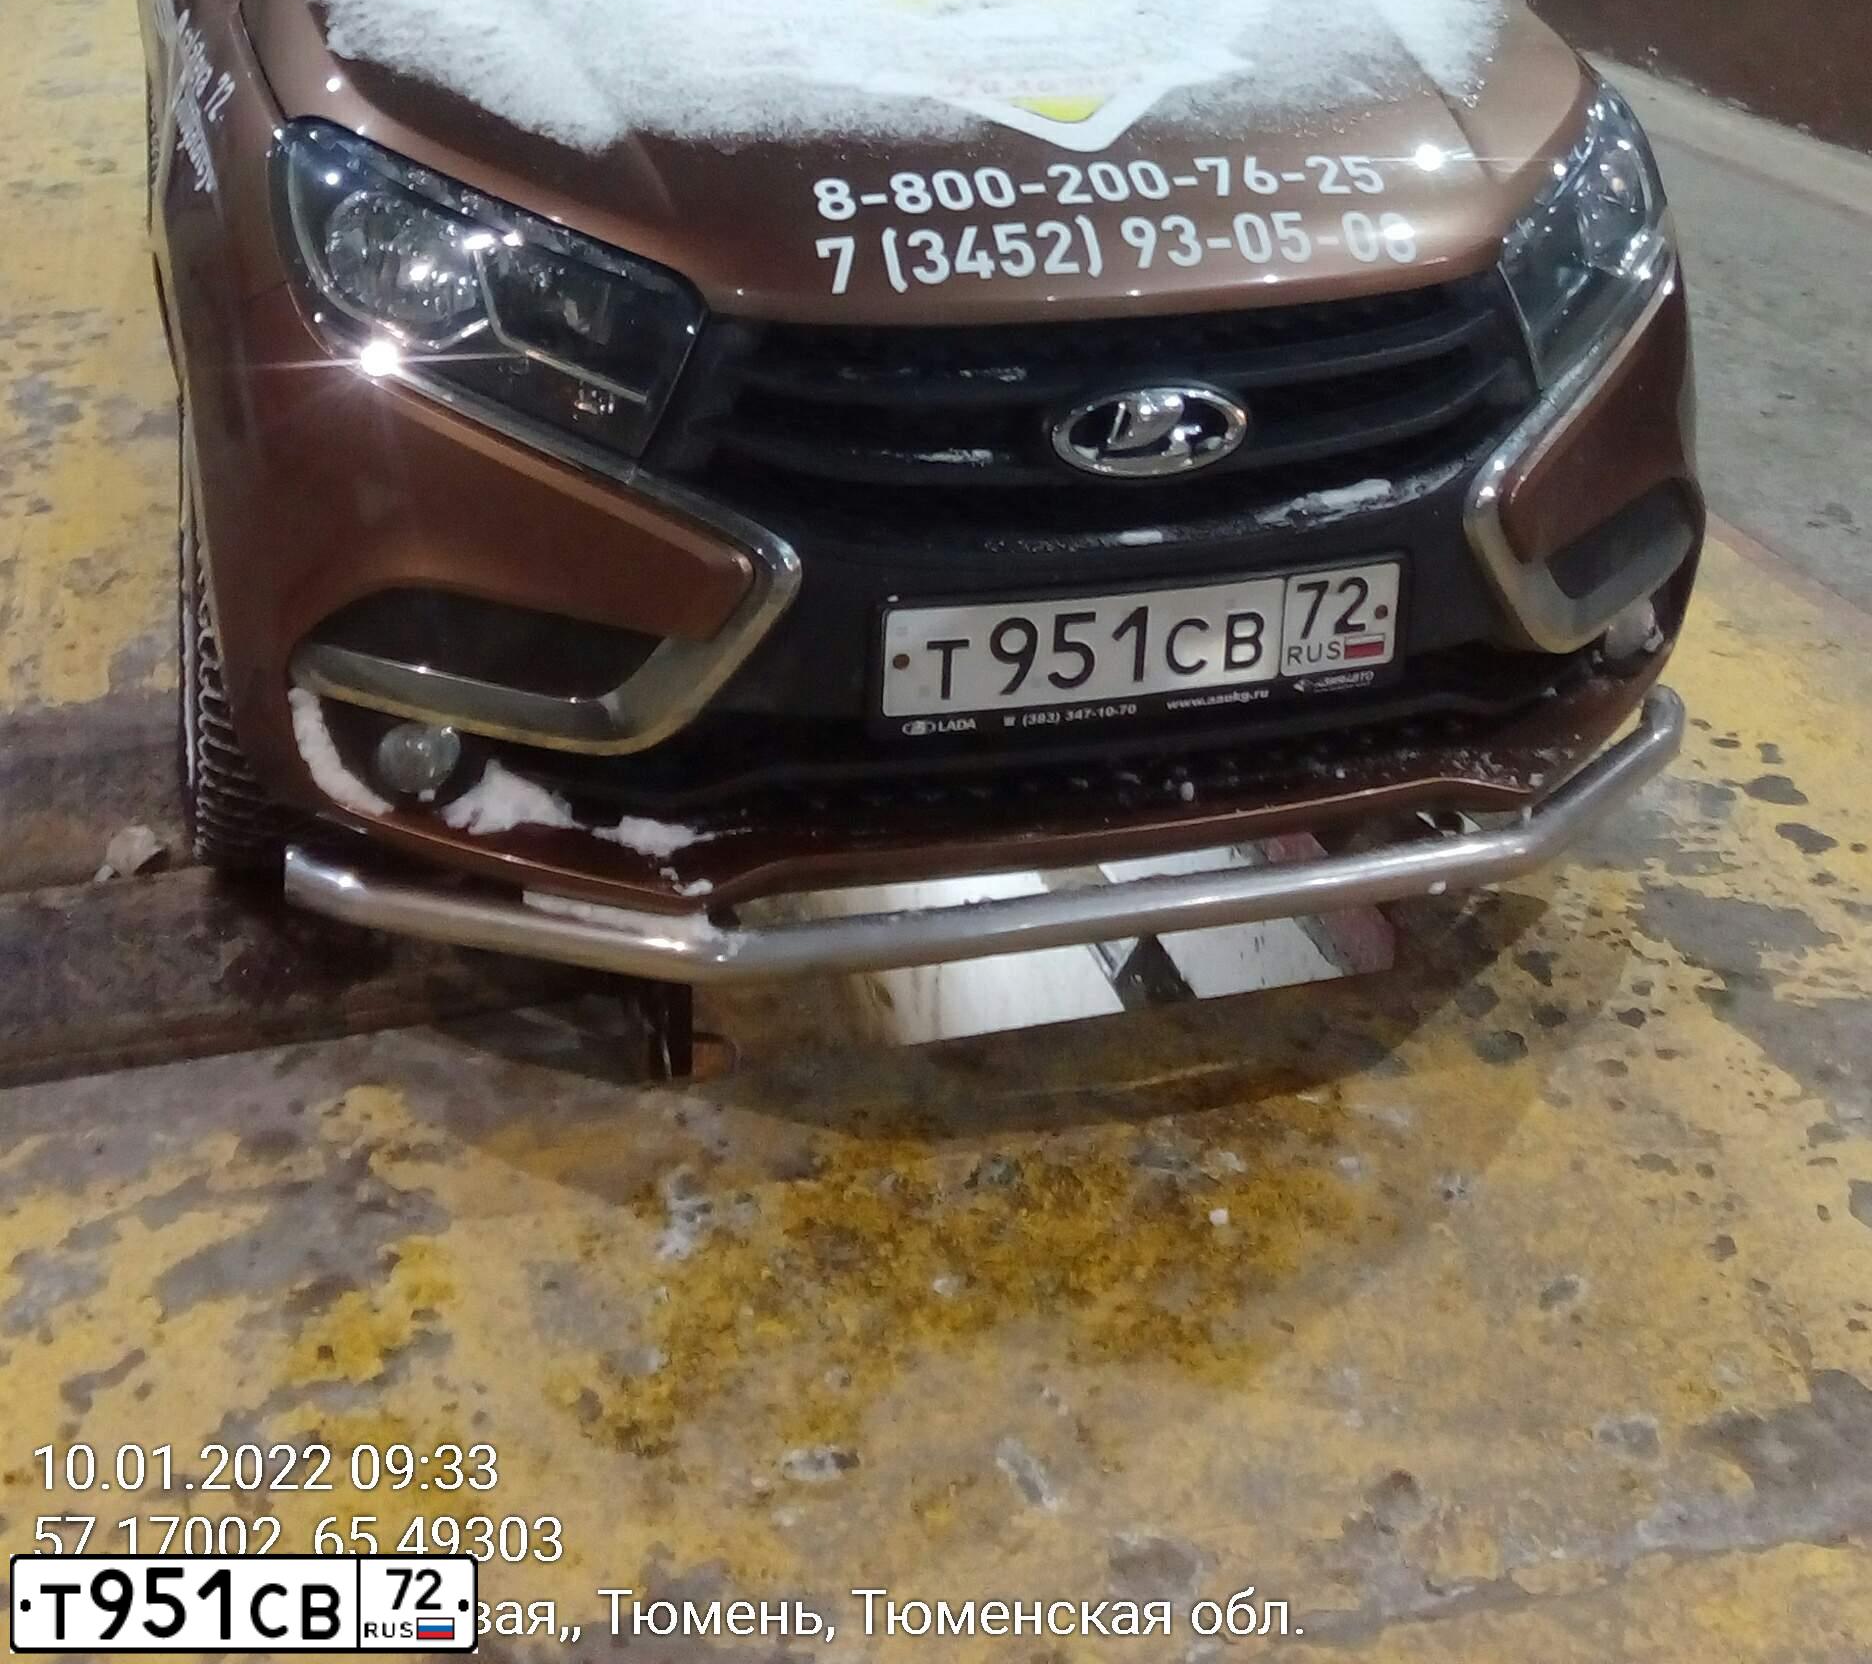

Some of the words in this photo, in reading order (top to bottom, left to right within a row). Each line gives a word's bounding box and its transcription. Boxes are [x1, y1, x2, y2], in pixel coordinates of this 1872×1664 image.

[812, 156, 1385, 221] 8-800-200-76-25
[815, 236, 856, 295] 7
[882, 214, 1102, 294] (3452)
[1296, 577, 1369, 639] 72
[1287, 640, 1342, 666] RUS
[937, 717, 977, 733] LADA
